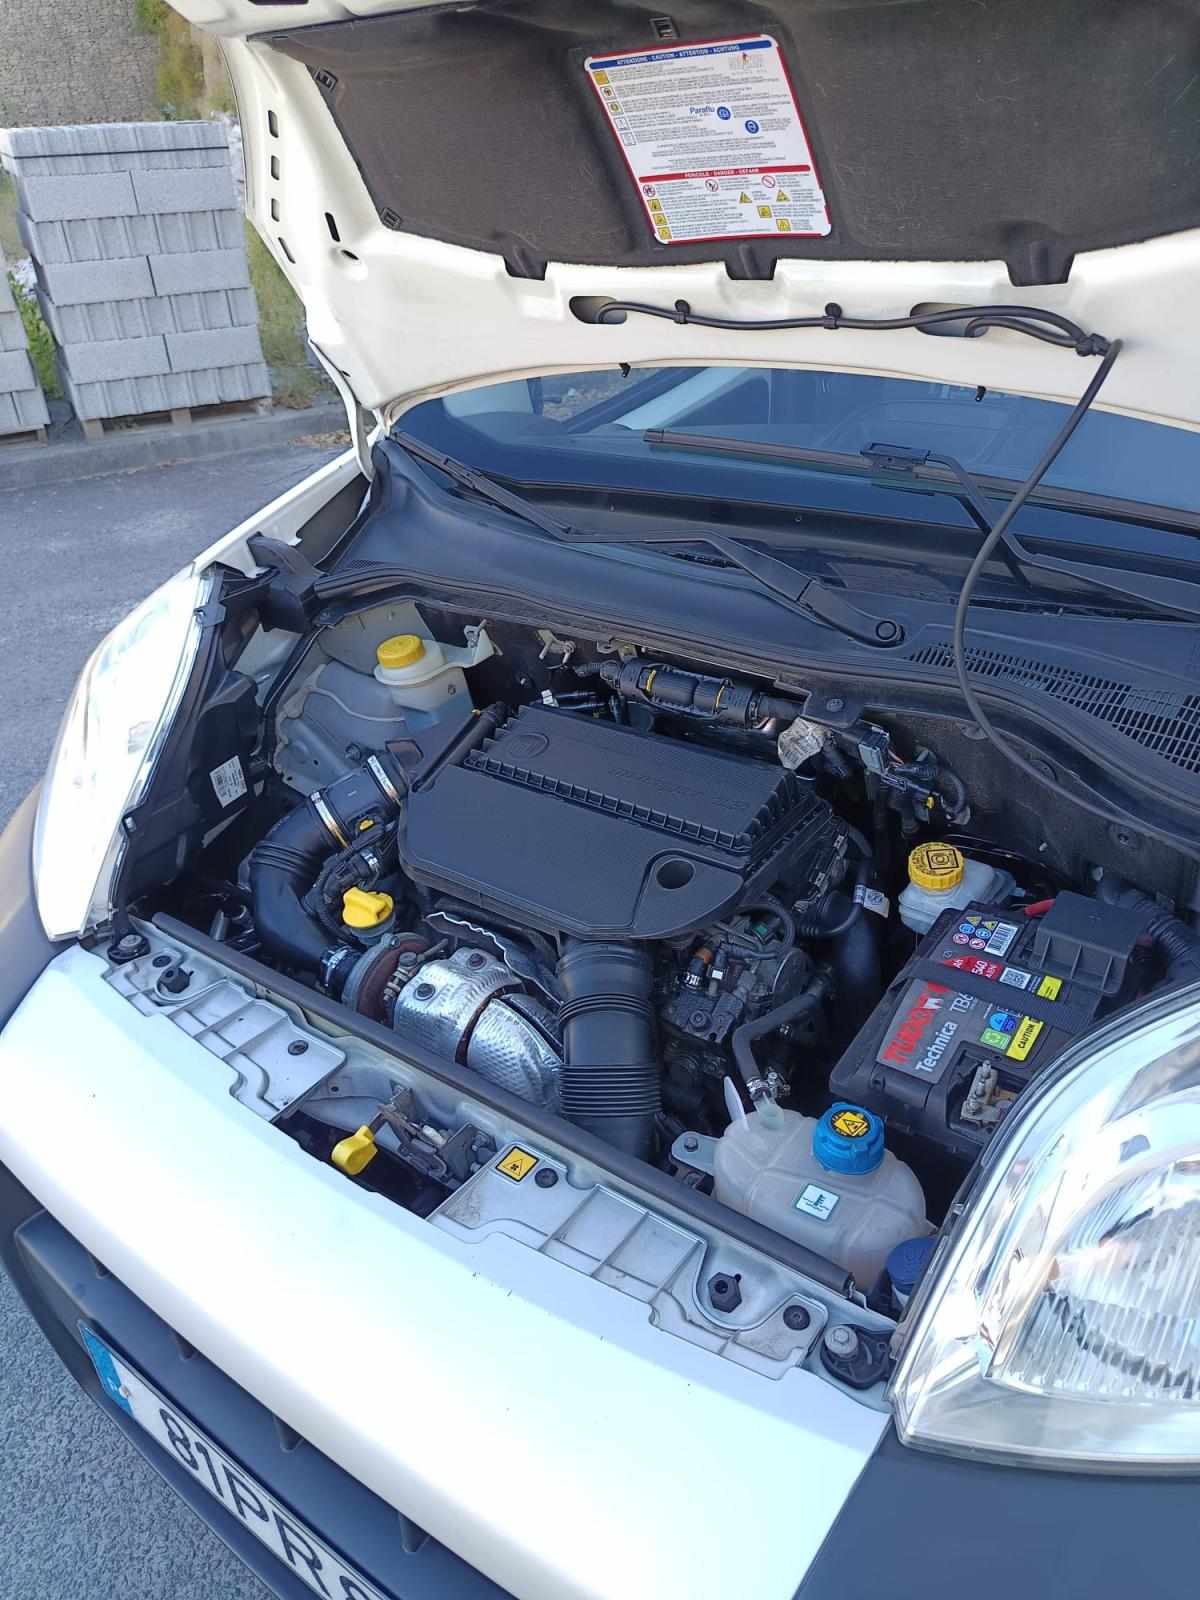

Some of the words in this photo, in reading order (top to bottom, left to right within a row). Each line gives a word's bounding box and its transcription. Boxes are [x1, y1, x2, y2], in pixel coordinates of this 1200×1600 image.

[689, 105, 716, 116] Paraflu
[915, 1021, 958, 1073] Technica
[1018, 1023, 1035, 1049] CAUTION
